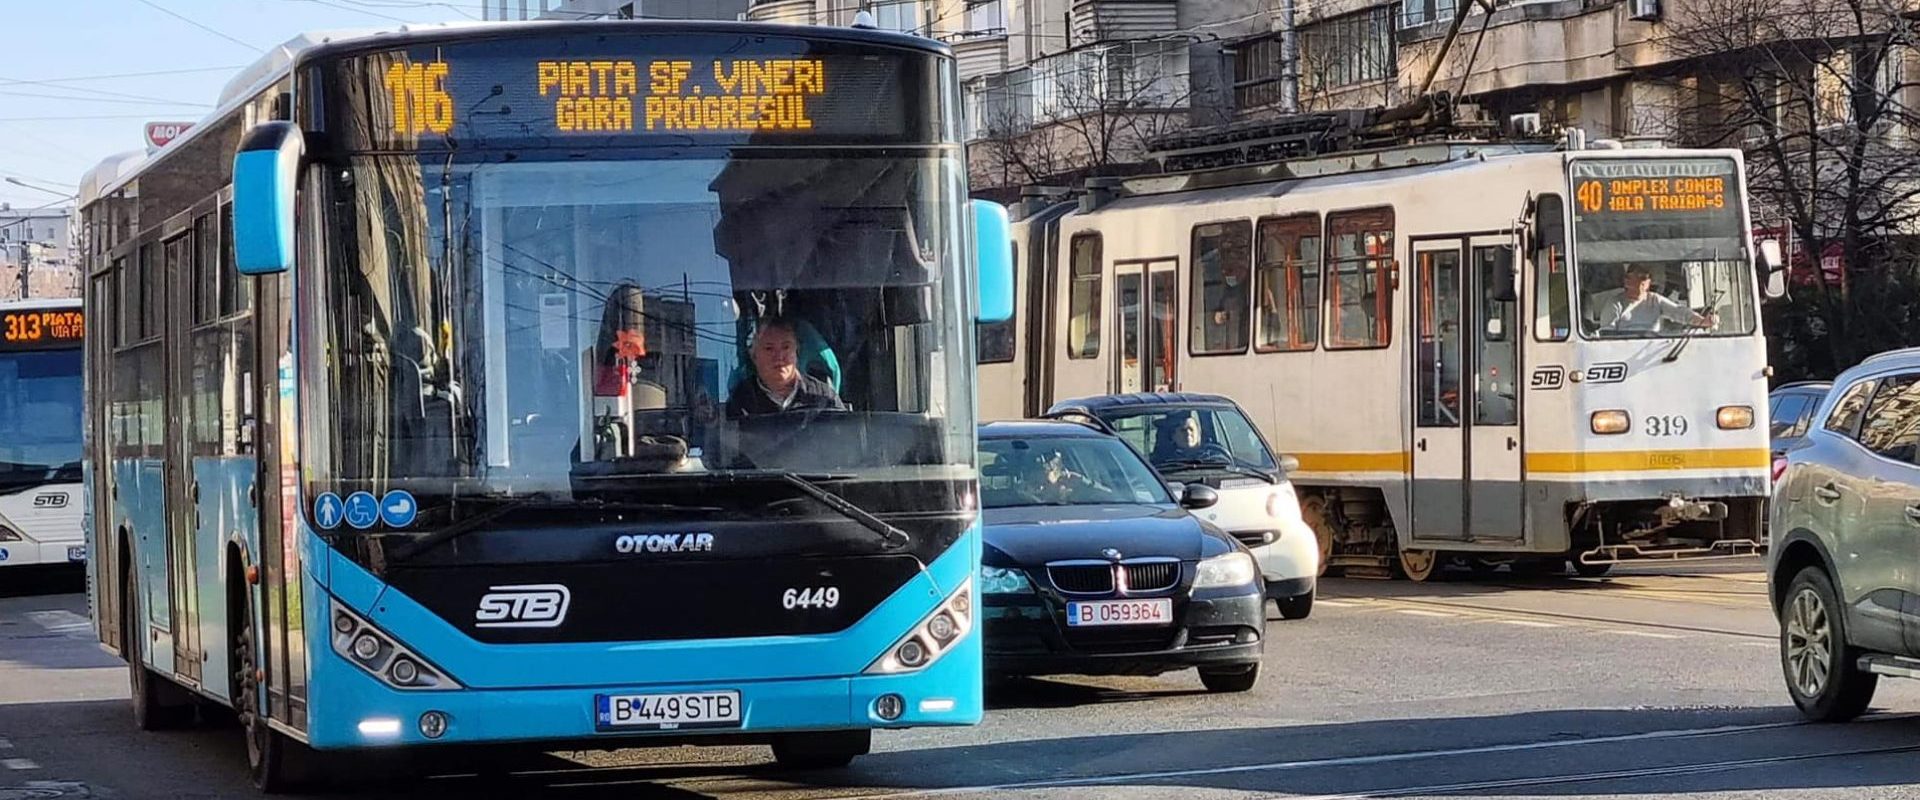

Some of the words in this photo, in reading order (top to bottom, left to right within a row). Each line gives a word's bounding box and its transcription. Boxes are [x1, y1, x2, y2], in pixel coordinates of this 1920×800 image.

[538, 61, 637, 95] PIATA
[650, 61, 701, 94] SF.
[714, 60, 825, 94] VINERI
[385, 62, 453, 134] 116
[556, 97, 633, 131] GARA
[645, 96, 813, 130] PROGRESUL
[1577, 180, 1603, 213] 40
[1608, 179, 1669, 196] OMPLEX
[1675, 178, 1723, 194] COMER
[4, 313, 41, 340] 313
[42, 312, 83, 326] PIATA
[51, 325, 70, 338] VIA
[1531, 370, 1562, 386] STB
[1586, 366, 1624, 380] STB
[1645, 415, 1688, 437] 319
[615, 532, 714, 553] OTOKAR
[475, 590, 562, 621] STB
[782, 586, 840, 609] 6449
[1081, 605, 1093, 622] B
[1100, 603, 1161, 621] 059364
